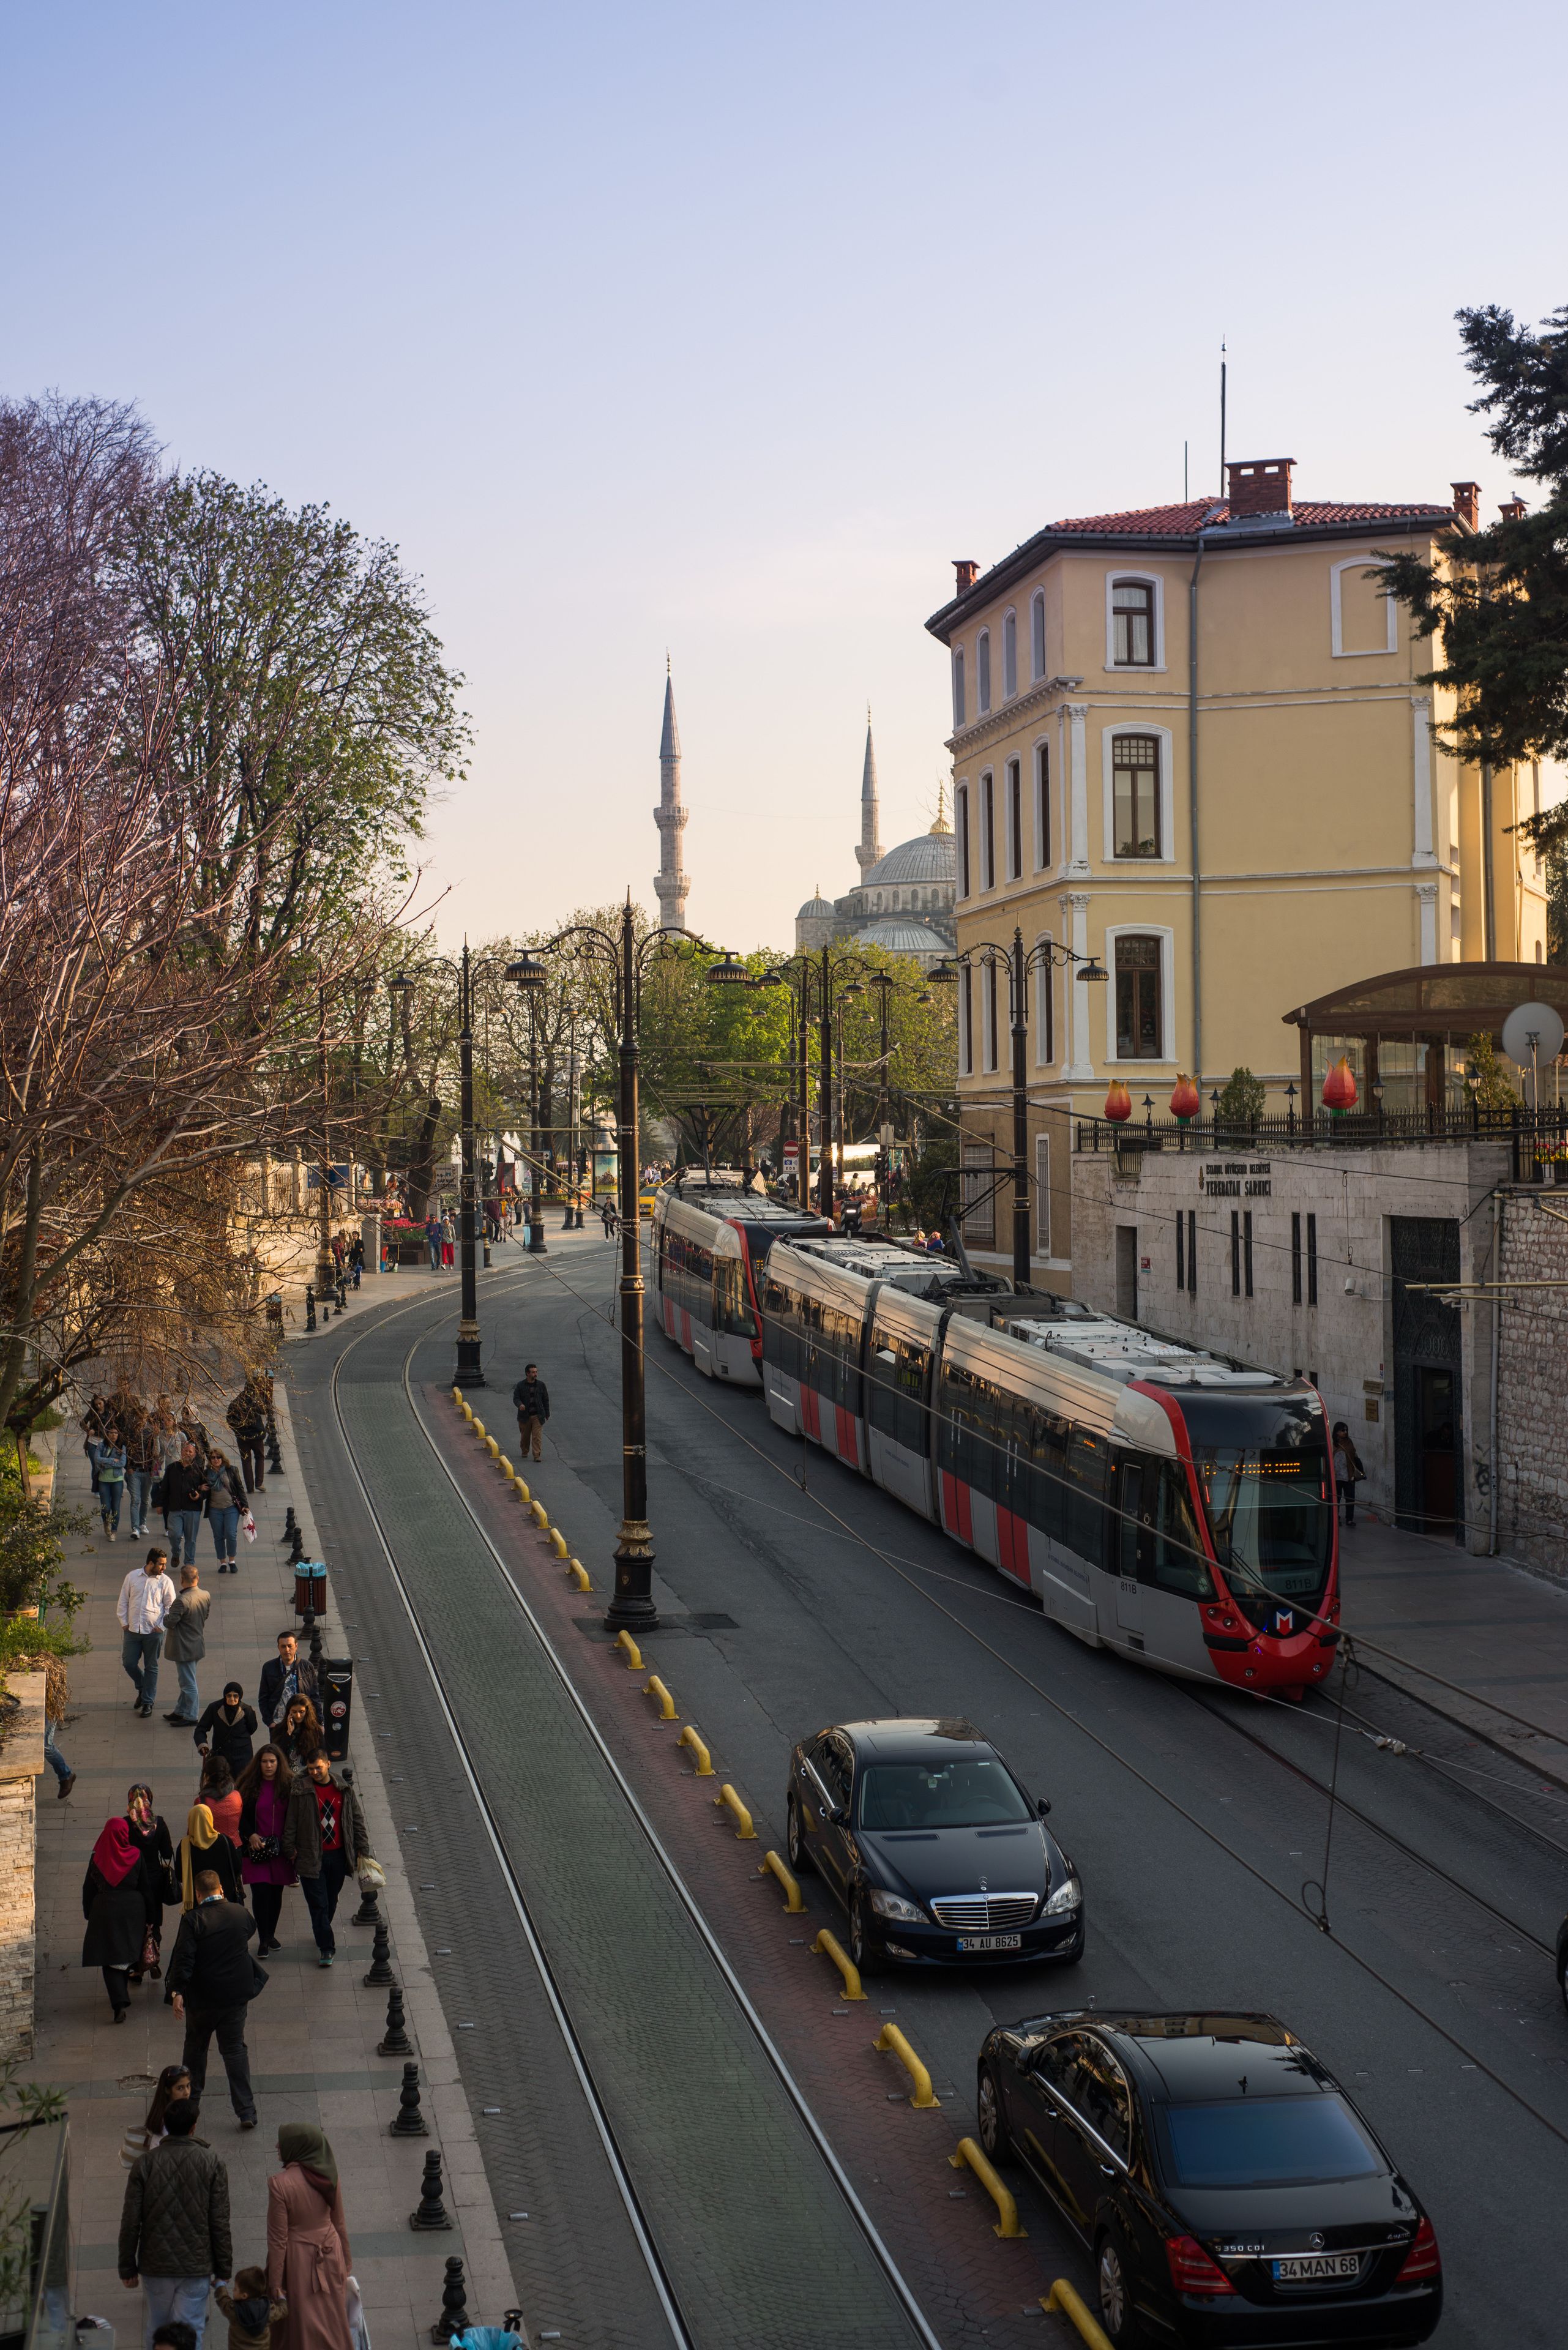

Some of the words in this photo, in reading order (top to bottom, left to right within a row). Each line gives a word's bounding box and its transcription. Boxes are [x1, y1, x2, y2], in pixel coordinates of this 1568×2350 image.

[1206, 1163, 1223, 1174] İSTANBUL
[1249, 1162, 1271, 1174] BELEDİYESİ
[1206, 1181, 1241, 1196] YEREBATAN
[1245, 1180, 1271, 1196] SARNICI
[1121, 1581, 1137, 1594] 811B
[1285, 1578, 1312, 1590] 811B
[963, 1938, 974, 1949] 34
[980, 1938, 991, 1949] AU
[995, 1936, 1018, 1947] 8625
[1280, 2262, 1297, 2277] 34
[1300, 2258, 1336, 2277] MAN
[1340, 2257, 1357, 2273] 68
